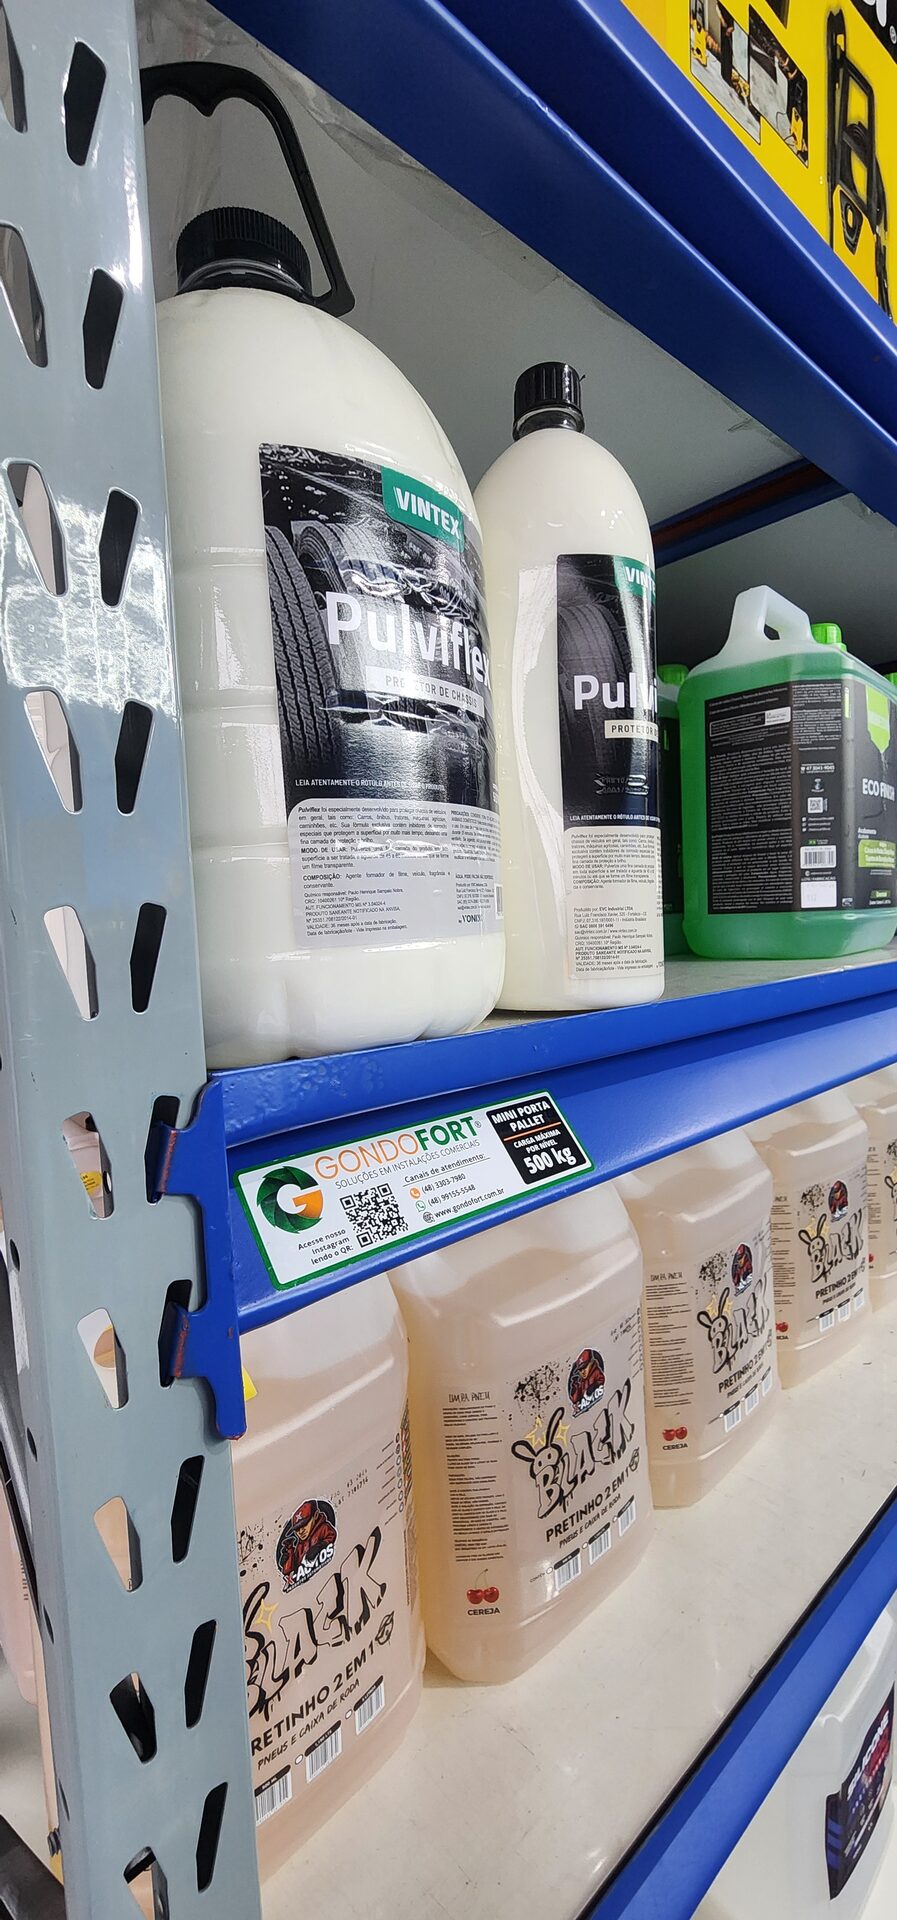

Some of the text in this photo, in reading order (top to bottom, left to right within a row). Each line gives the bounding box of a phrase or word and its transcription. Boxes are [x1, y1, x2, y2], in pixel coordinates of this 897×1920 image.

[394, 486, 461, 540] VINTEX
[326, 591, 491, 690] Pulviflex
[440, 686, 450, 698] DE
[612, 725, 654, 736] PROTETOR
[862, 778, 879, 797] ECO
[491, 1100, 550, 1125] MINI PORTA
[510, 1114, 546, 1132] PALLET
[514, 1129, 561, 1148] CARGA MÁXIMA
[526, 1139, 557, 1153] POR NÍVEL
[335, 1139, 480, 1190] SOLUÇÕES EM INSTALAÇÕES COMERCIAIS
[404, 1154, 486, 1183] Canais de atendimento:
[523, 1147, 576, 1174] 500 kg
[421, 1173, 466, 1194] (48) 3303-7980
[428, 1184, 476, 1207] (48) 99155-5548
[434, 1188, 504, 1219] www.gondofort.com.br
[298, 1228, 347, 1250] Acesse nosso
[312, 1237, 350, 1255] Instagram
[311, 1252, 333, 1265] lendo
[340, 1244, 354, 1255] QR:
[709, 1272, 770, 1374] BLACK
[718, 1360, 753, 1393] PRETINHO
[531, 1378, 634, 1519] BLACK
[662, 1443, 688, 1451] CEREJA
[546, 1493, 603, 1542] PRETINHO
[604, 1485, 611, 1501] 2
[612, 1475, 625, 1494] EM
[560, 1530, 578, 1548] PNEUS
[467, 1608, 500, 1616] CEREJA
[250, 1686, 329, 1756] RETINHO
[333, 1673, 343, 1693] 2
[346, 1653, 368, 1681] EM
[368, 1640, 374, 1655] 1
[258, 1741, 289, 1770] PNEUS
[290, 1734, 297, 1746] E
[299, 1712, 325, 1737] CAIXA
[327, 1702, 339, 1715] DE
[339, 1678, 360, 1703] RODA
